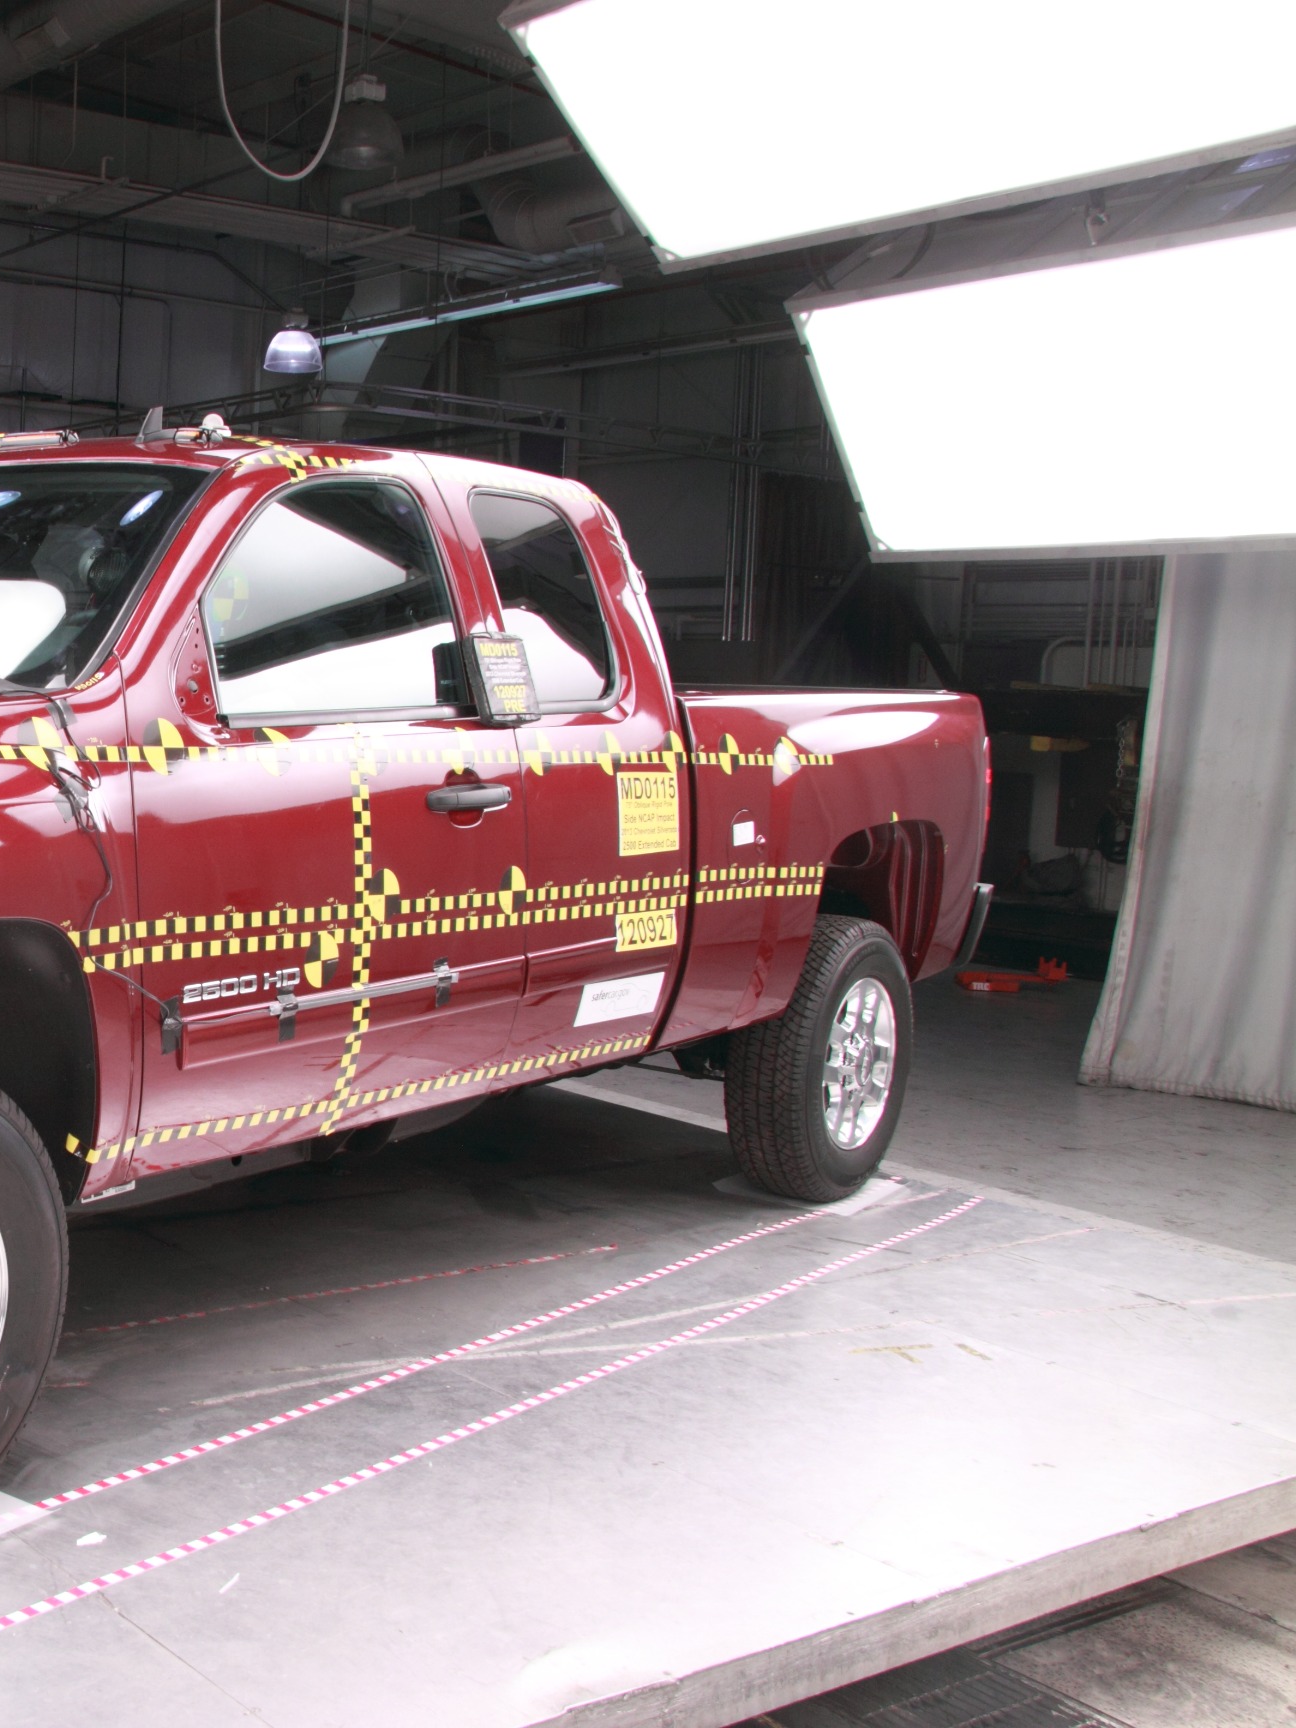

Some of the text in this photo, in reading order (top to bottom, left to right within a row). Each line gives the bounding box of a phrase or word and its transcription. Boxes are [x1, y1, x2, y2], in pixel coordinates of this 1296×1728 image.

[479, 643, 519, 657] MD0115
[493, 685, 527, 698] 120927
[503, 699, 527, 713] PRE
[620, 777, 676, 800] MD0115
[624, 813, 675, 824] Side NCAP Impact
[638, 840, 665, 850] Extended
[666, 838, 677, 848] Cab
[618, 914, 674, 946] 120927
[182, 967, 301, 1004] 2500 HD
